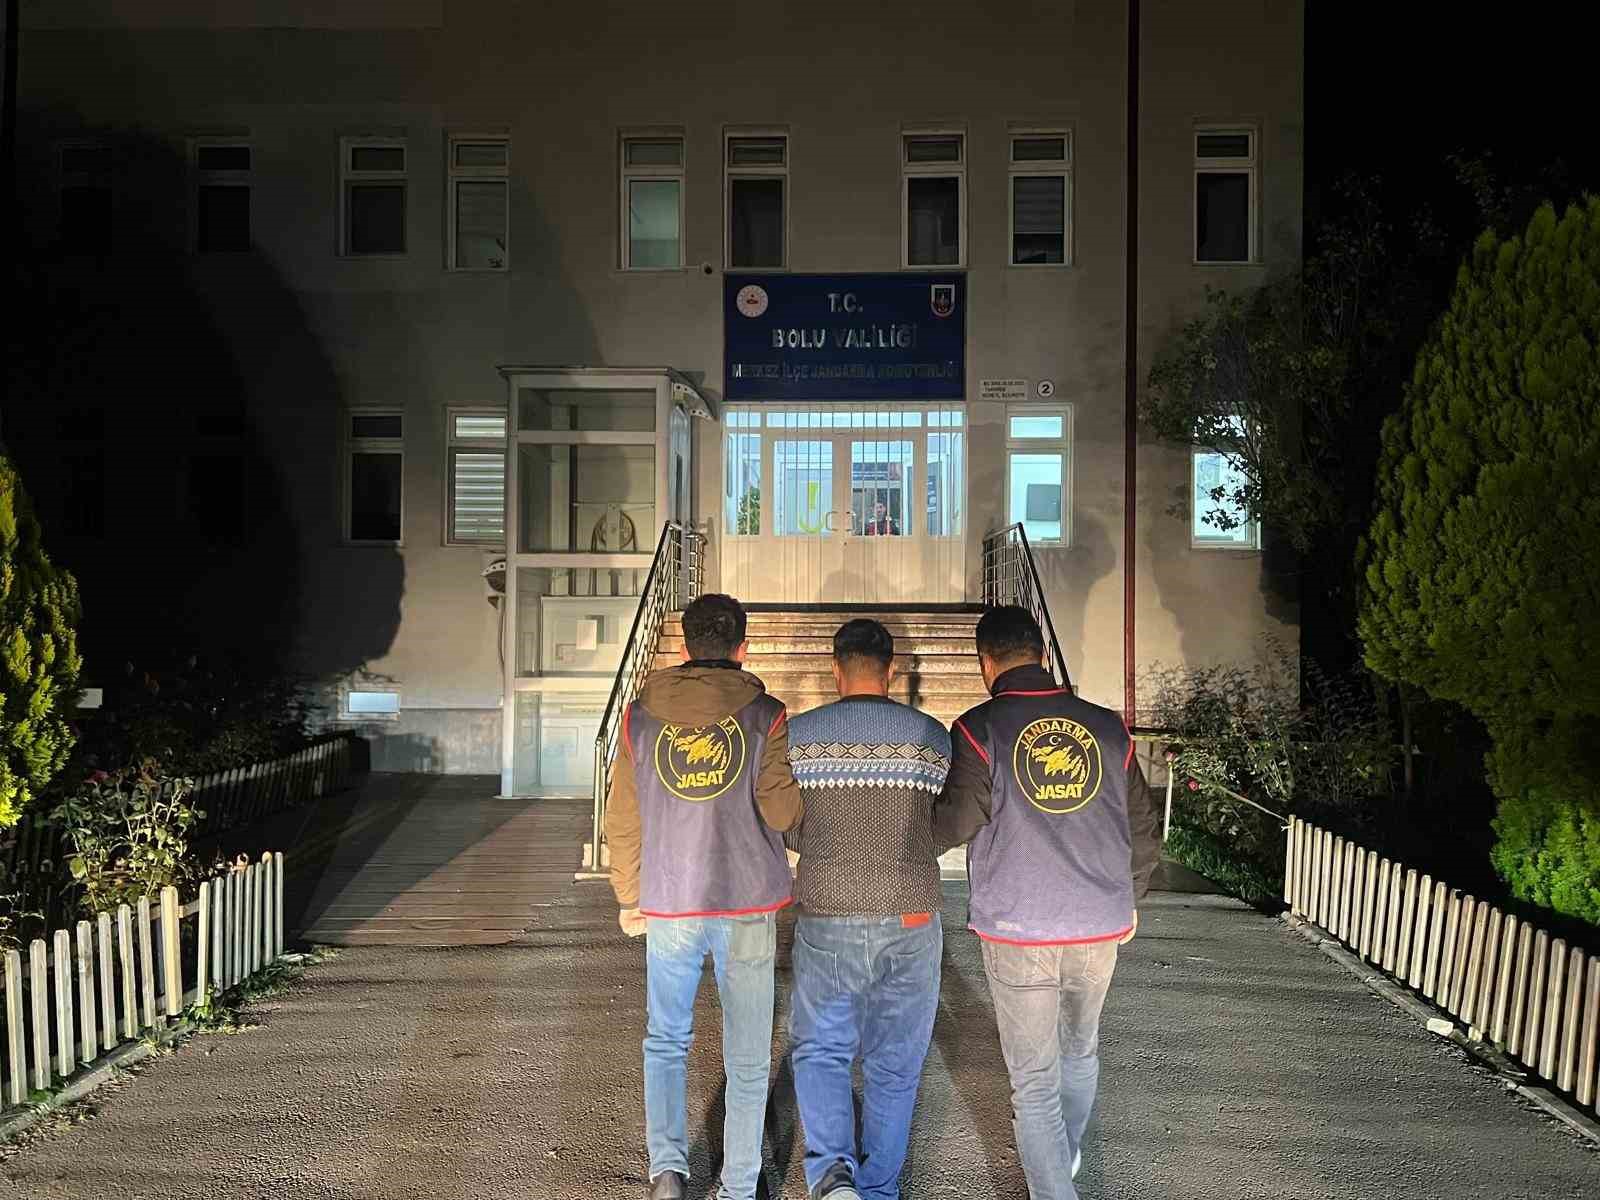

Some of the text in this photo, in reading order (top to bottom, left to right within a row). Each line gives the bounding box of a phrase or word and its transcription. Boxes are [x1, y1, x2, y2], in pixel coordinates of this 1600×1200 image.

[828, 293, 863, 313] T.C.
[772, 328, 826, 349] BOLU
[1041, 384, 1050, 394] 2
[1020, 720, 1093, 750] JANDARMA
[676, 769, 726, 789] JASAT
[1035, 783, 1085, 800] JASAT
